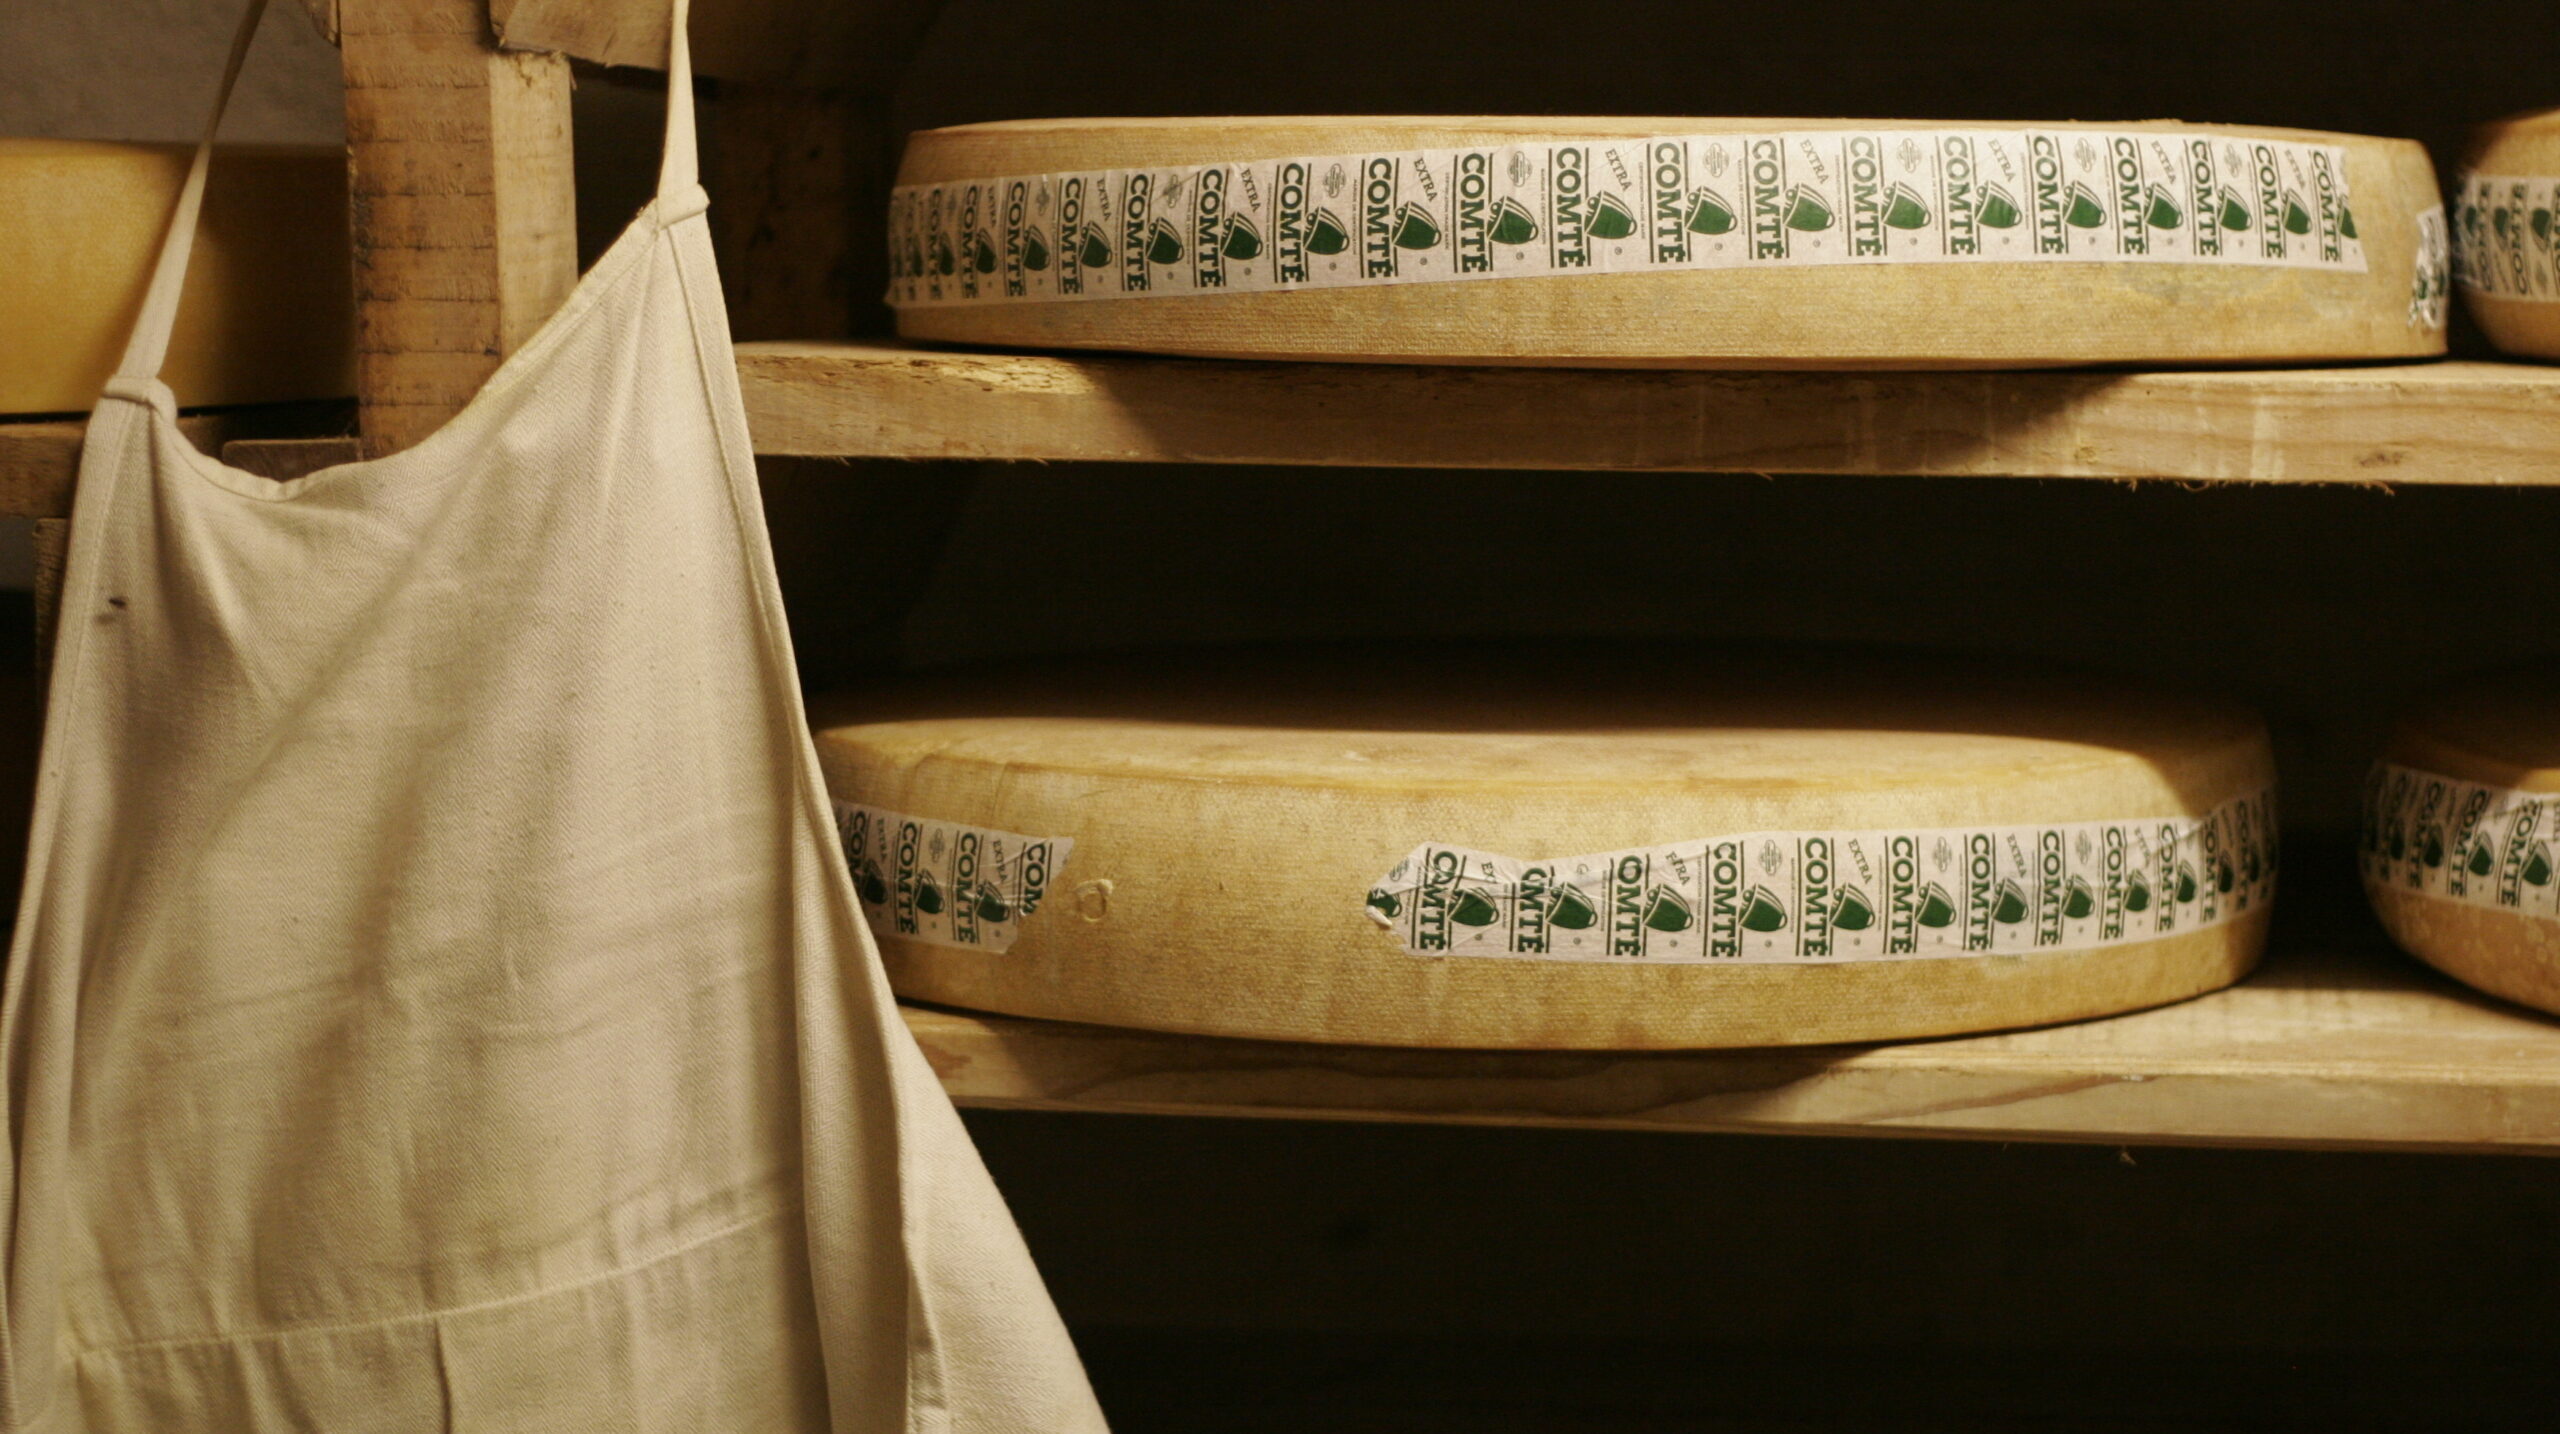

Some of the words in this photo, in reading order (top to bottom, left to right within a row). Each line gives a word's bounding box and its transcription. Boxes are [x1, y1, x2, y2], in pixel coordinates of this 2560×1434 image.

[1414, 157, 1436, 202] EXTRA
[1605, 148, 1632, 192] EXTRA
[1800, 139, 1828, 185] EXTRA
[1988, 138, 2014, 183] EXTRA
[2151, 140, 2177, 185] EXTRA
[1096, 178, 1111, 222] EXTRA
[1241, 168, 1259, 213] EXTRA
[1848, 838, 1873, 885] EXTRA
[2007, 833, 2027, 878] EXTRA
[1021, 843, 1045, 916] COM
